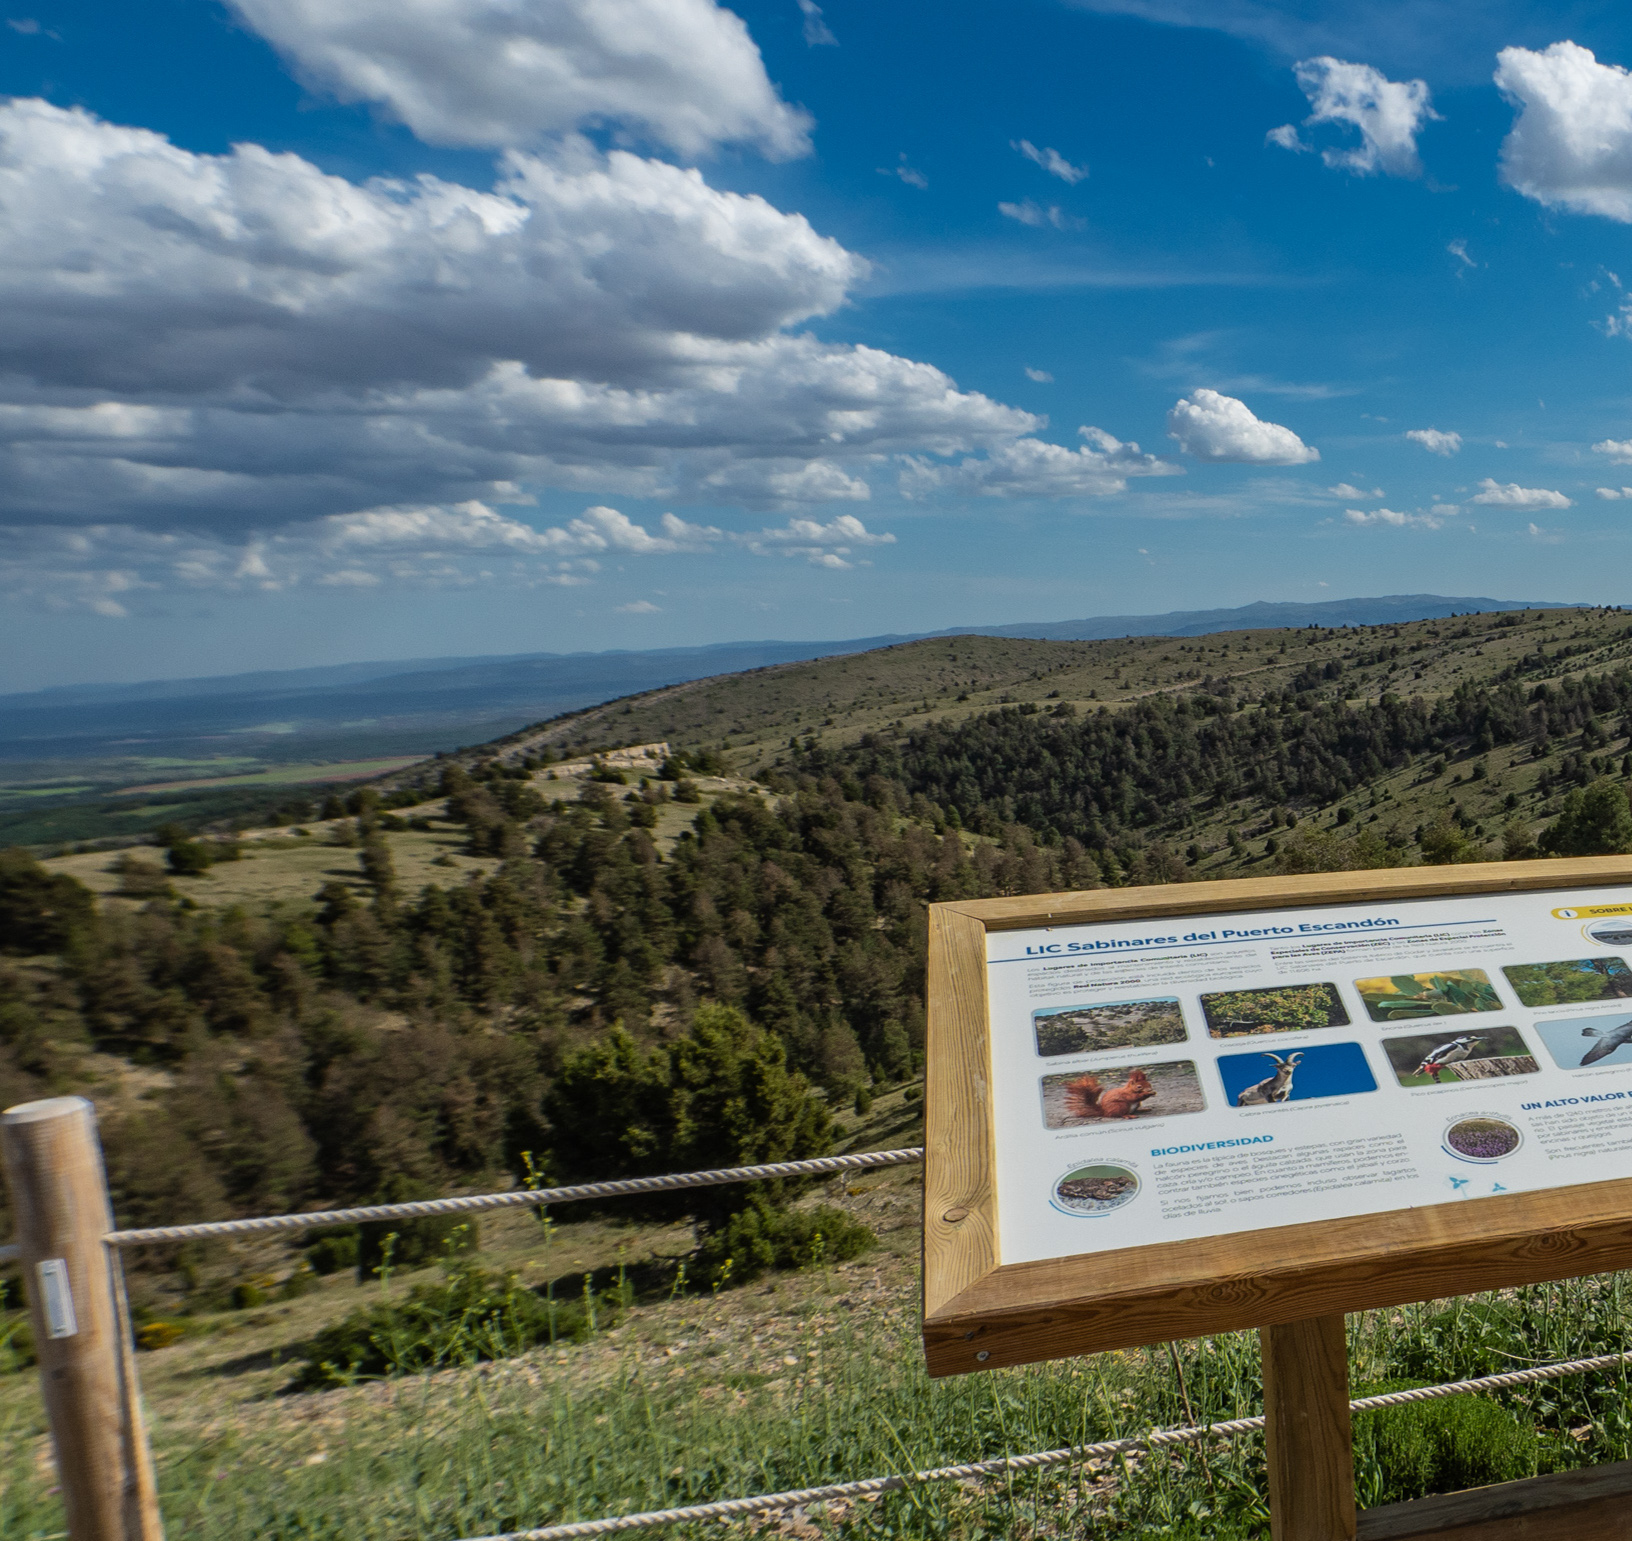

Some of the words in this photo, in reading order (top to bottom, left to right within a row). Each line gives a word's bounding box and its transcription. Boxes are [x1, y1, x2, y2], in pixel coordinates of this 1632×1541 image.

[1588, 907, 1628, 915] SOBRE
[1026, 945, 1062, 955] LIC
[1066, 937, 1178, 951] Sabinares
[1182, 931, 1217, 941] del
[1221, 927, 1294, 938] Puerto
[1297, 918, 1400, 932] Escandón
[1090, 959, 1139, 967] Importancia
[1520, 1102, 1543, 1110] UN
[1544, 1098, 1580, 1107] ALTO
[1579, 1092, 1627, 1103] VALOR
[1150, 1136, 1274, 1156] BIODIVERSIDAD
